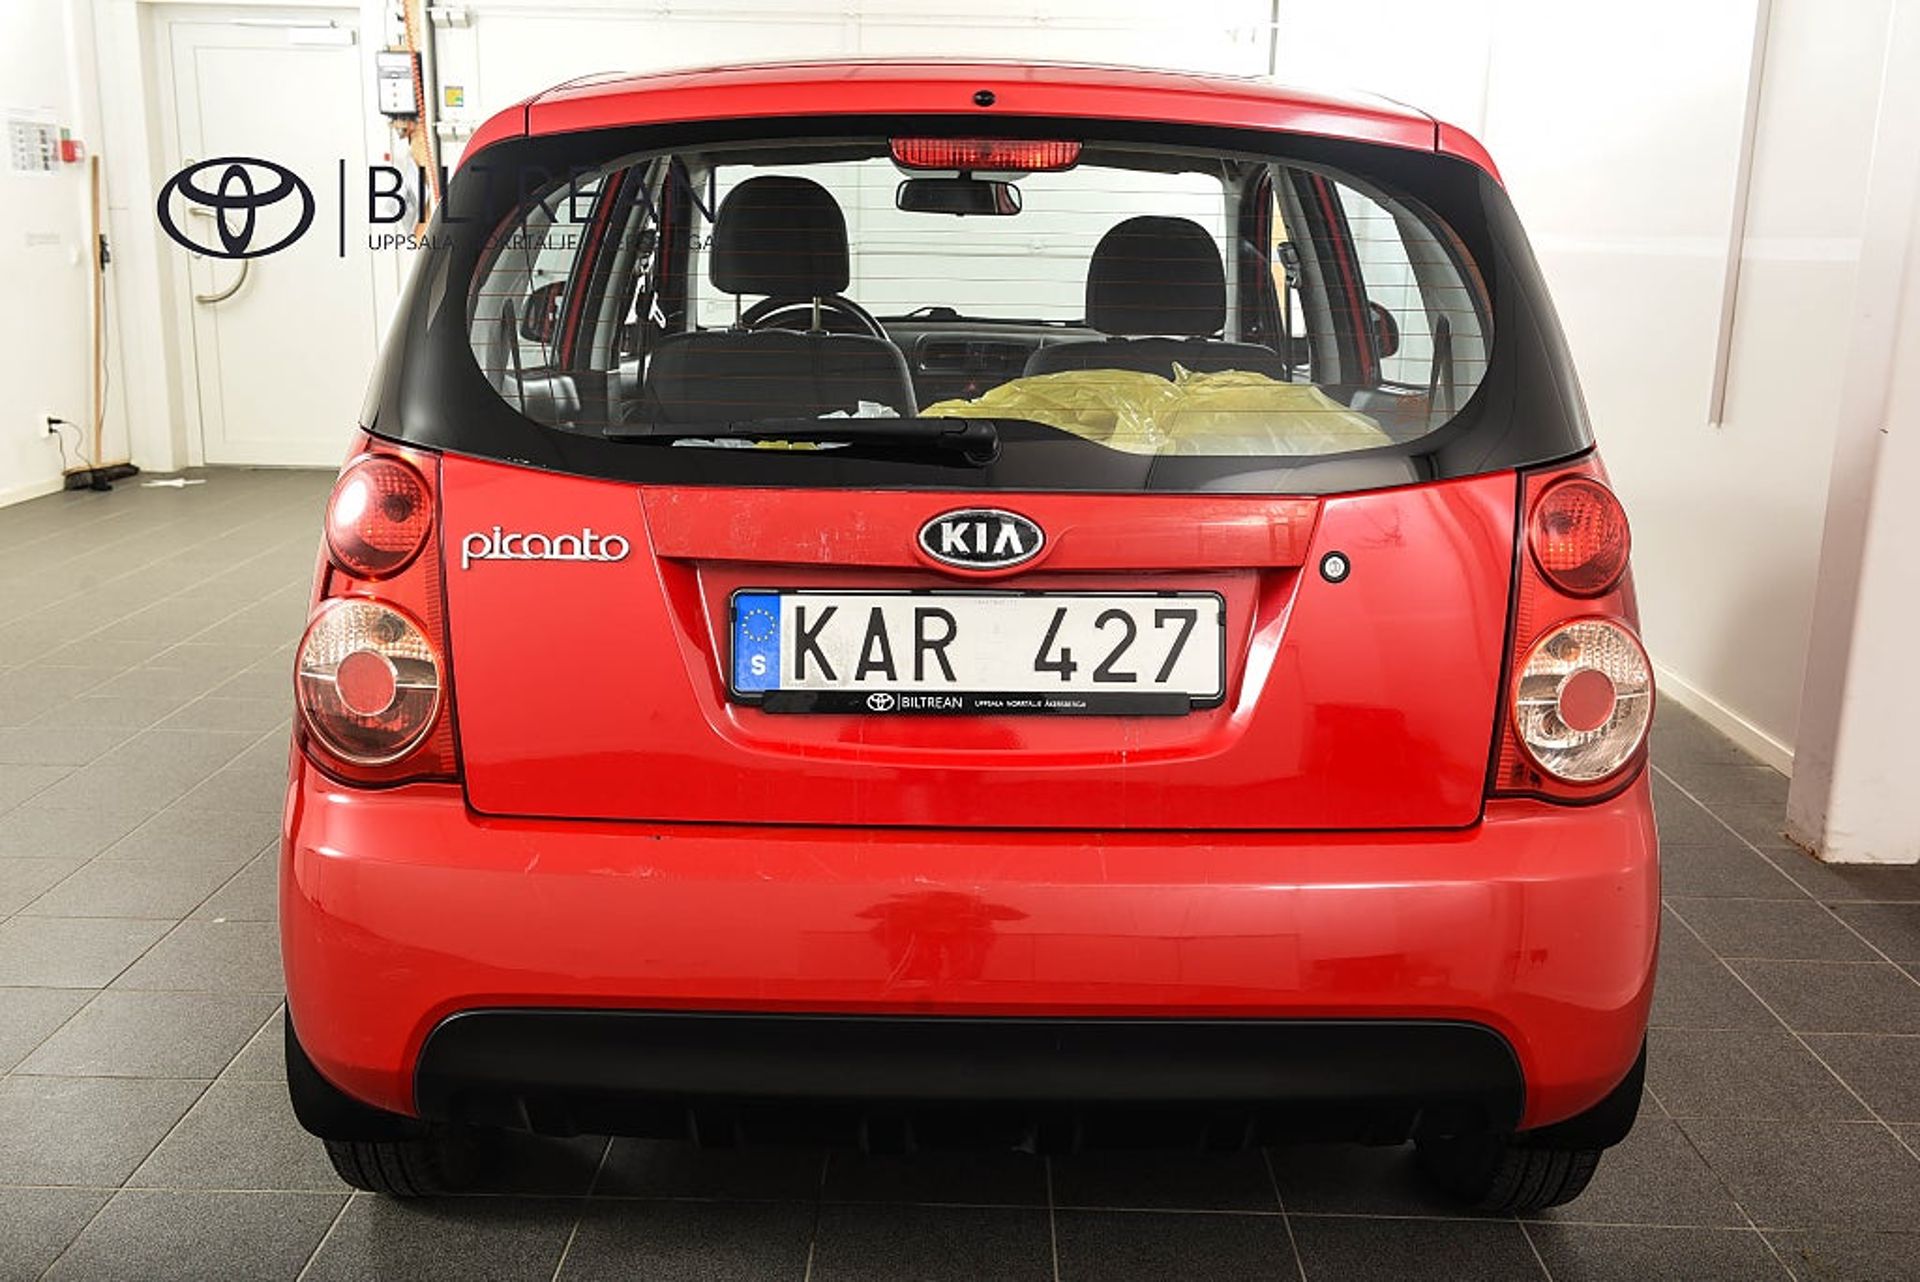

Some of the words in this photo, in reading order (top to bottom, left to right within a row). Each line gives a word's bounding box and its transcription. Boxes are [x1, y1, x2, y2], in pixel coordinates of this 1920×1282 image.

[461, 526, 630, 570] picanto
[941, 522, 1024, 554] KIA
[795, 606, 957, 682] KAR
[1034, 607, 1198, 683] 427
[750, 654, 767, 676] S
[901, 696, 963, 709] BILTREAN
